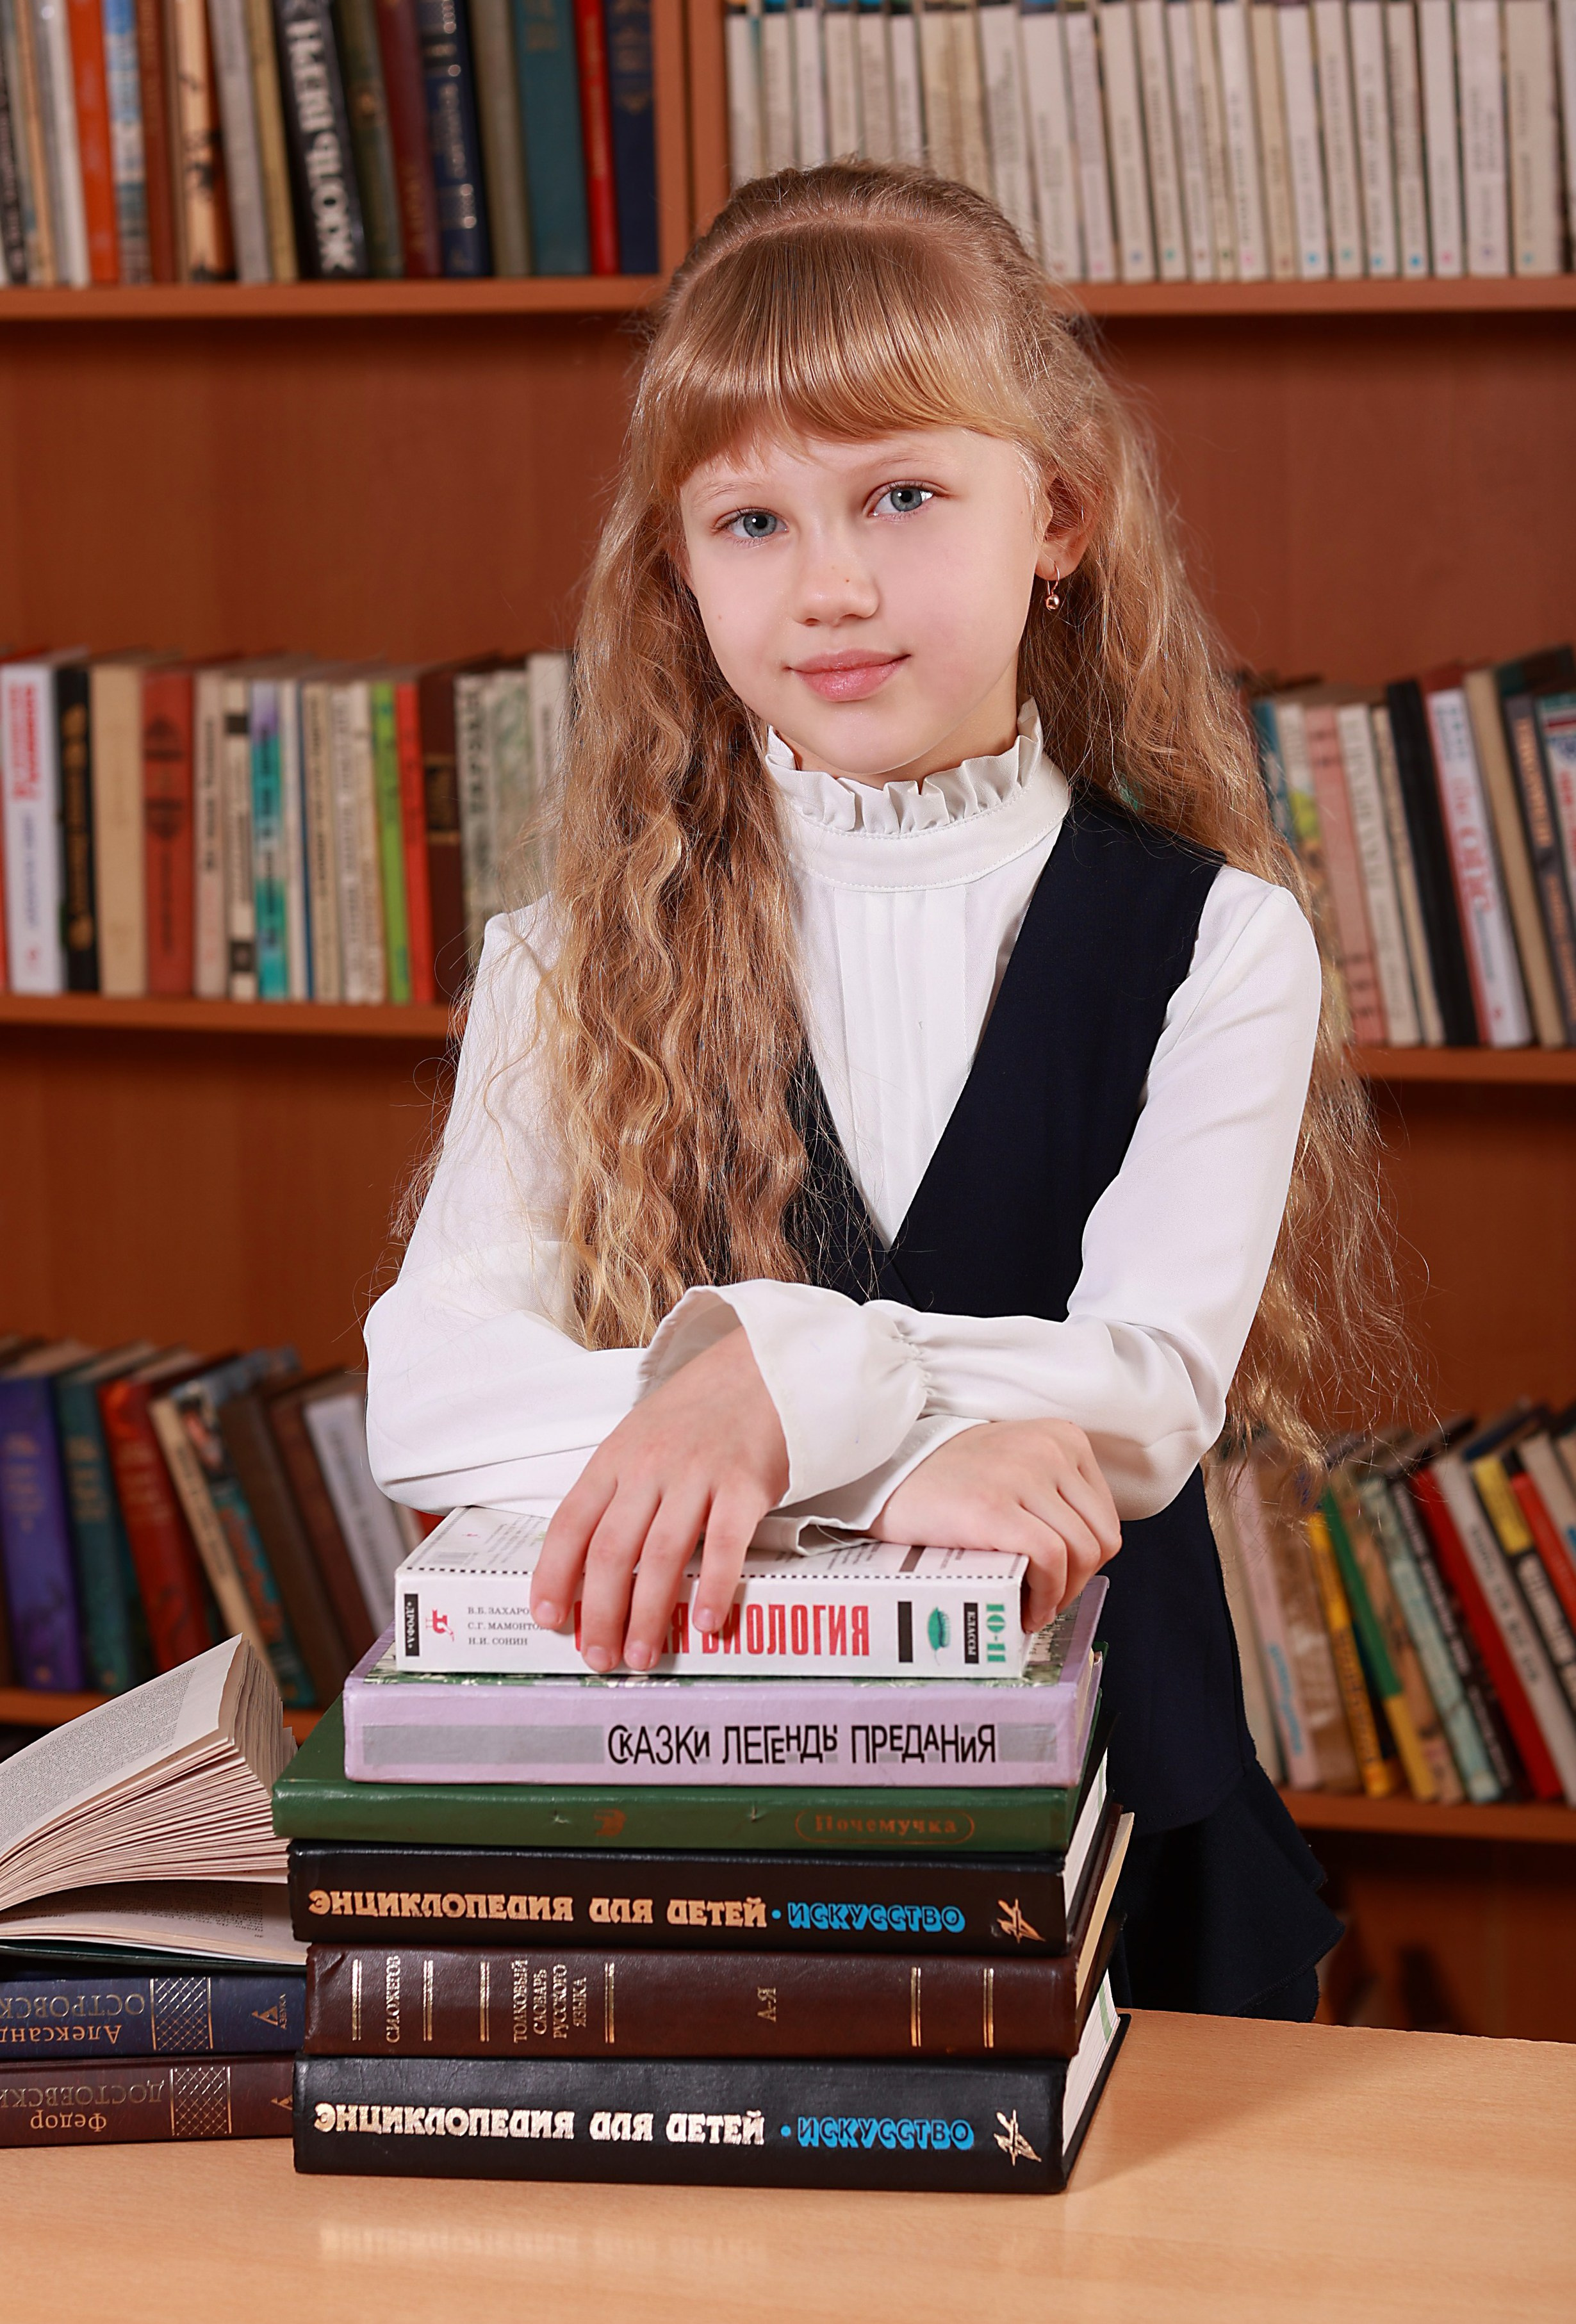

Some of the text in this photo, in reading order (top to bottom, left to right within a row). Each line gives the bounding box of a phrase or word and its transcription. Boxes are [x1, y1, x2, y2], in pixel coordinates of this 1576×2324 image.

[468, 1622, 550, 1631] С.Г. МАМОНТО
[488, 1607, 530, 1615] ЗАХАРО
[967, 1610, 976, 1656] КЛАССЫ
[986, 1603, 1006, 1663] 10-11
[468, 1637, 528, 1646] Н.И. СОНИН
[815, 1814, 958, 1837] Почемучка
[308, 1889, 966, 1933] ЭНЦИКЛОПЕДИЯ ДЛЯ ДЕТЕЙ ИСКУССТВО
[511, 1960, 529, 2044] ТОЛКОВЫЙ
[532, 1968, 547, 2034] СЛОВАРЬ
[552, 1963, 569, 2040] РУССКОГО
[572, 1977, 587, 2028] ЯЗЫКА
[757, 1986, 776, 2022] А-Я
[30, 2109, 107, 2132] Федор
[313, 2102, 975, 2150] ЭНЦИКЛОПЕДИЯ ДЛЯ ДЕТЕЙ ИСКУССТВО
